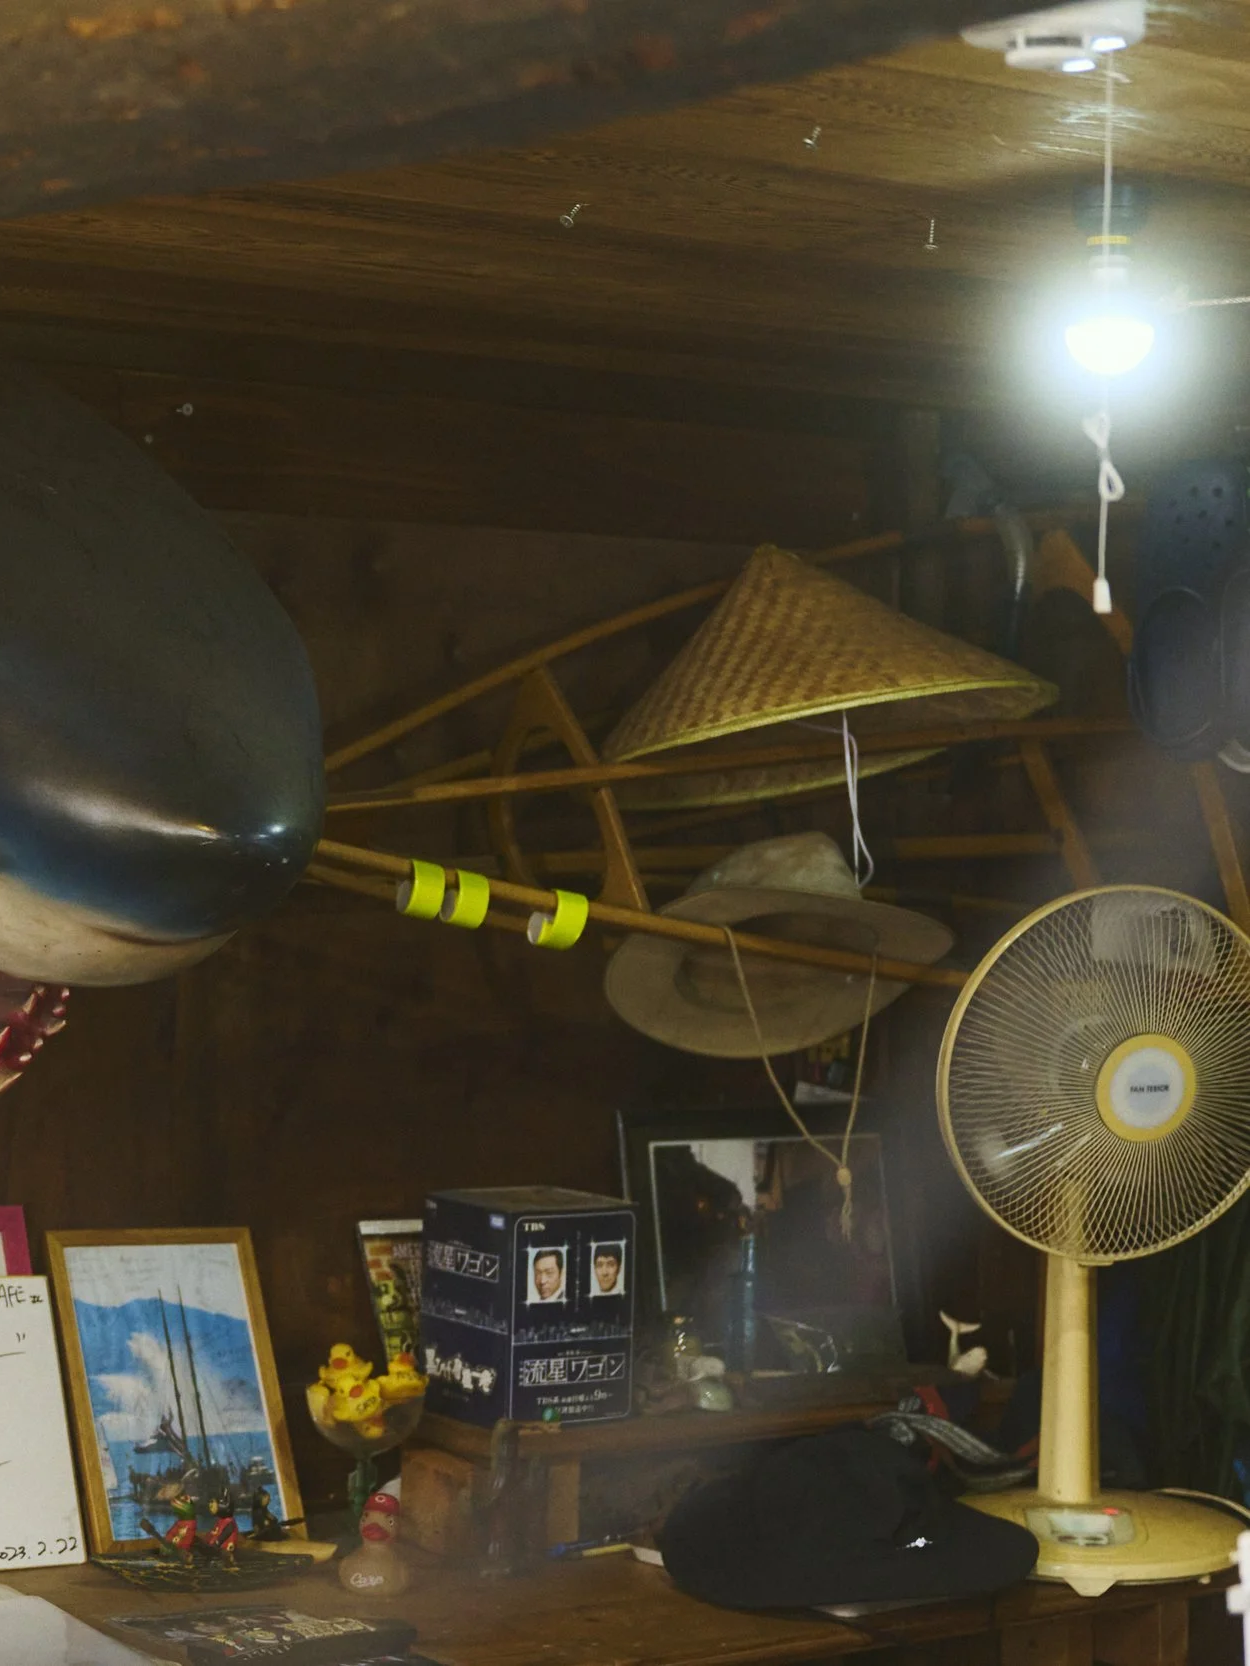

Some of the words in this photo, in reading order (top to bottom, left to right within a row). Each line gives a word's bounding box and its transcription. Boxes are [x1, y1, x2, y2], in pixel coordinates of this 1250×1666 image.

[523, 1222, 546, 1232] TBS
[522, 1356, 626, 1386] 流星ワゴン
